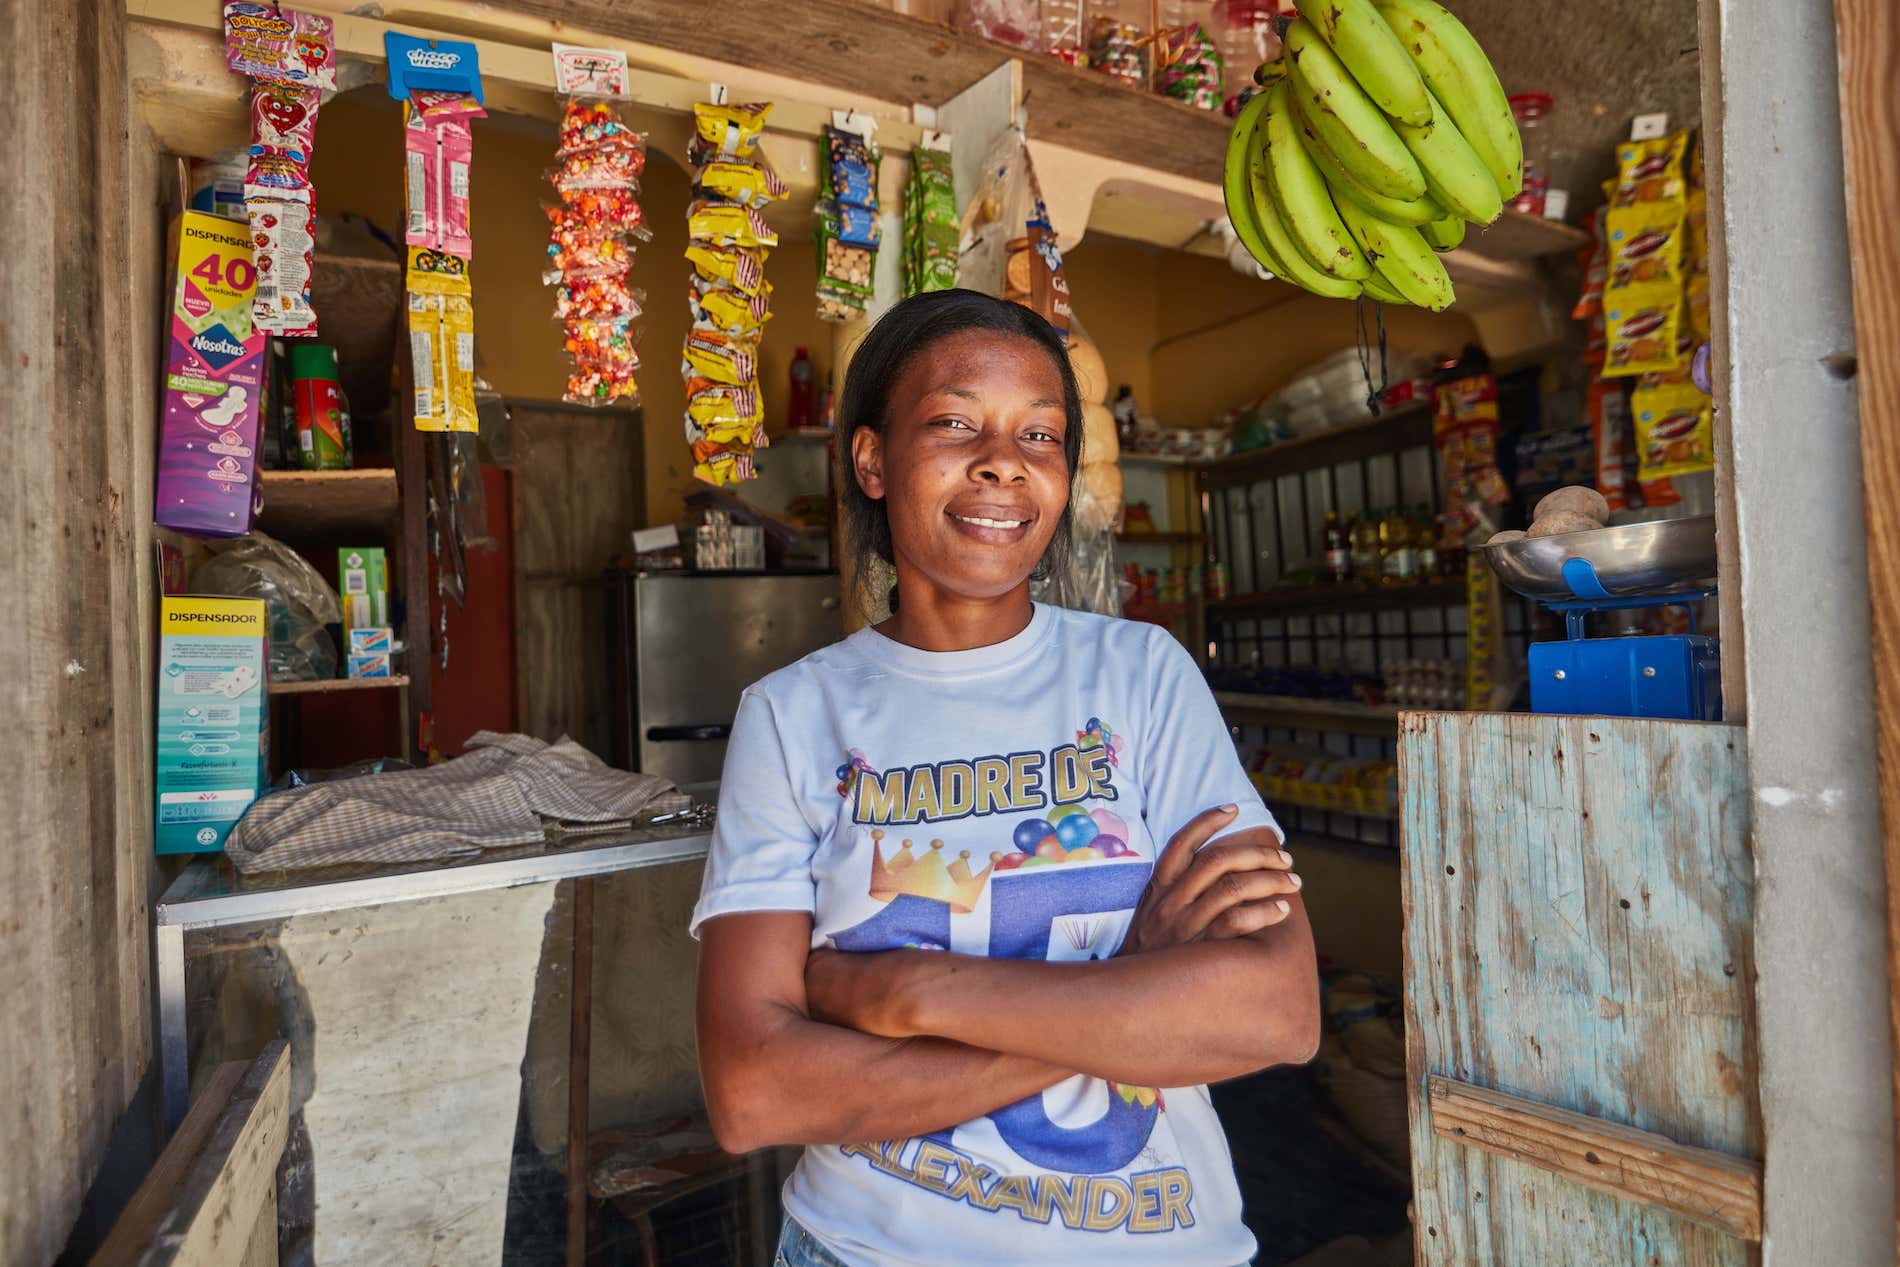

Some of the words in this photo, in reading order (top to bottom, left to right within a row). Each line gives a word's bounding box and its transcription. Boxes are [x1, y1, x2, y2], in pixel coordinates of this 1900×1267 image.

[407, 48, 461, 63] choco
[192, 253, 257, 291] 40
[193, 335, 247, 357] Nosotras
[169, 612, 257, 624] DISPENSADOR
[852, 749, 1044, 826] MADRE
[1050, 744, 1119, 805] DE
[841, 1138, 1196, 1234] ALEXANDER
